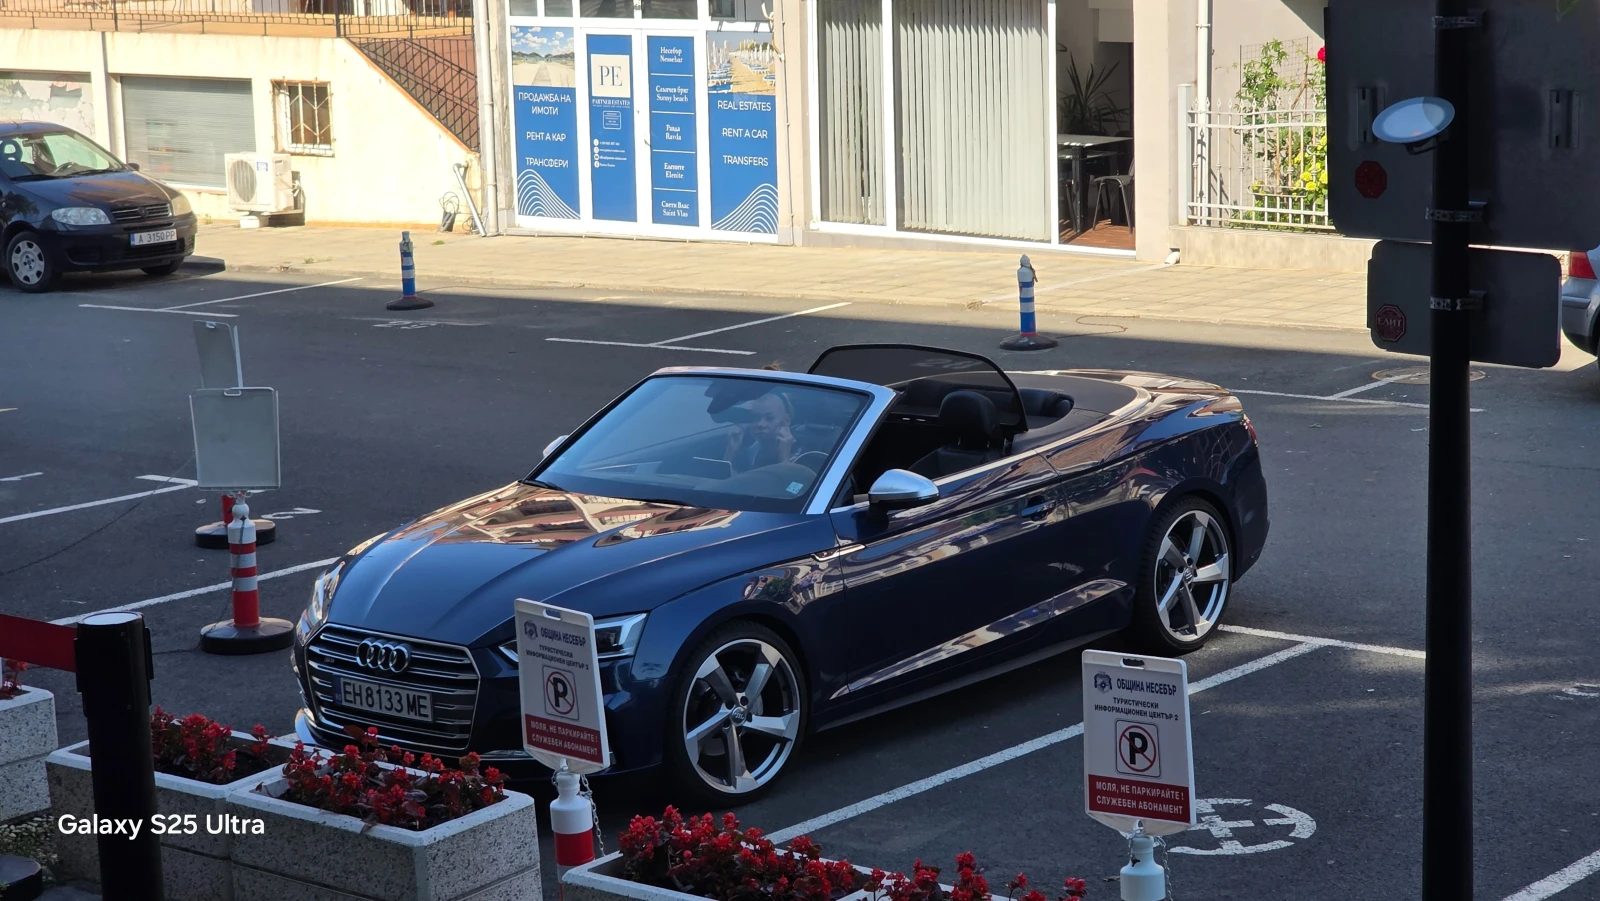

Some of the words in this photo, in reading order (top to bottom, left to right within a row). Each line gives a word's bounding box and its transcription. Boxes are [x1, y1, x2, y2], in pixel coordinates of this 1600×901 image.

[660, 55, 683, 63] Nessebar
[598, 65, 622, 86] PE
[518, 92, 559, 102] ПРОДАЖБА
[560, 94, 571, 103] НА
[656, 94, 672, 103] Sunny
[531, 106, 558, 115] ИМОТИ
[717, 100, 738, 110] REAL
[740, 101, 772, 111] ESTATES
[526, 132, 544, 140] РЕНТ
[552, 134, 566, 142] КАР
[666, 132, 681, 140] Ravda
[722, 128, 743, 137] RENT
[744, 129, 750, 138] A
[752, 129, 768, 138] CAR
[525, 157, 568, 168] ТРАНСФЕРИ
[723, 155, 768, 166] TRANSFERS
[540, 627, 562, 641] ОБЩИНА
[562, 632, 586, 647] НЕСЕБЪР
[1116, 678, 1144, 693] ОБЩИНА
[1146, 681, 1177, 696] НЕСЕБЪР
[1113, 697, 1158, 709] ТУРИСТИЧЕСКИ
[1094, 704, 1148, 717] ИНФОРМАЦИОНЕН
[1148, 711, 1173, 720] ЦЕНТЪР
[550, 724, 557, 734] НЕ
[532, 733, 563, 748] СЛУЖЕБЕН
[564, 738, 598, 755] АБОНАМЕНТ
[1096, 781, 1119, 793] МОЛЯ,
[1120, 784, 1130, 794] НЕ
[1096, 797, 1136, 809] СЛУЖЕБЕН
[1138, 800, 1183, 815] АБОНАМЕНТ
